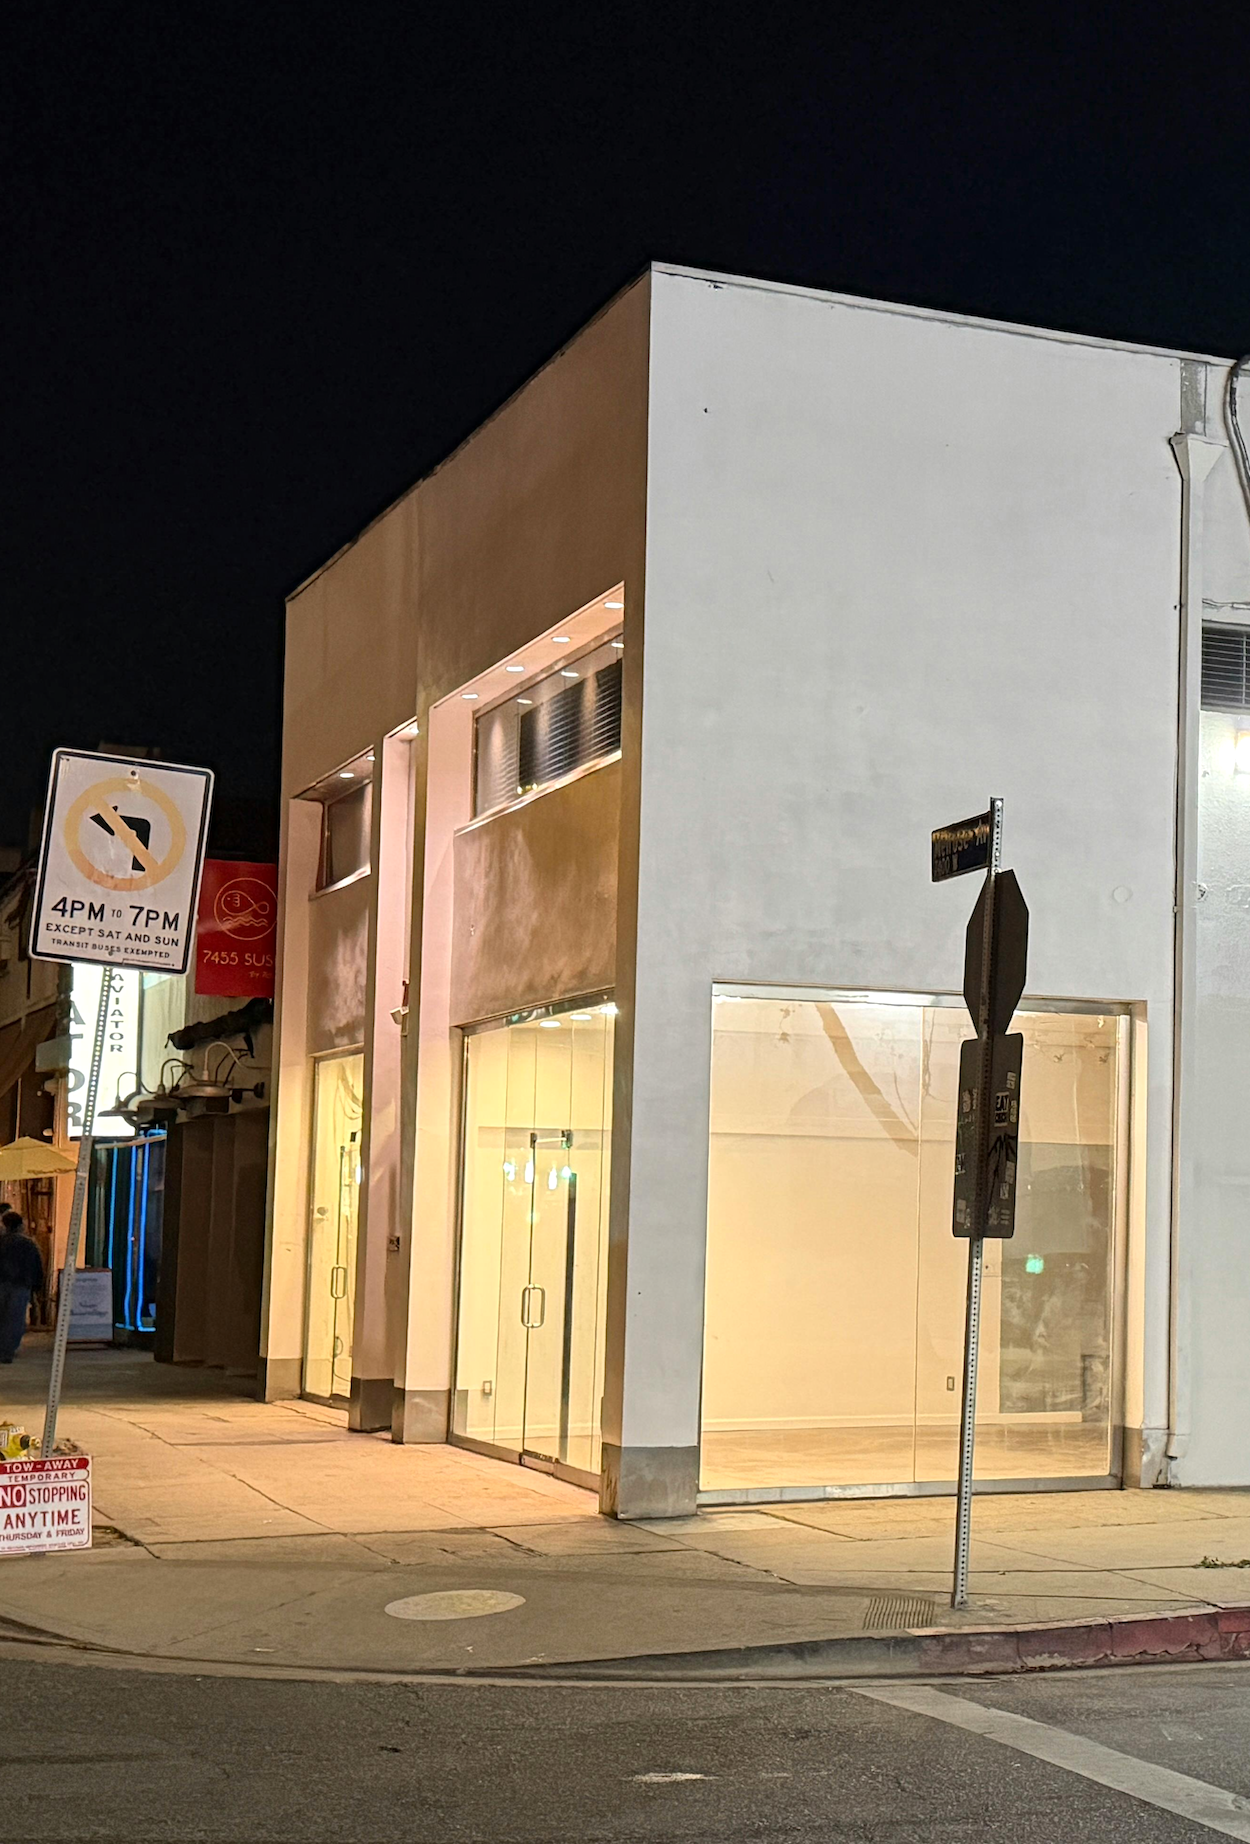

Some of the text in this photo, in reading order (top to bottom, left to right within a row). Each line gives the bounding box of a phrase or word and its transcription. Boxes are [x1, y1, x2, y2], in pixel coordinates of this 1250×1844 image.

[51, 896, 180, 931] 4PM TO 7PM
[45, 922, 180, 947] EXCEPT SAT AND SUN
[51, 938, 170, 959] TRANSIT BUSES EXEMPTED
[203, 951, 241, 965] 7455
[109, 974, 124, 1053] AVIATOR
[9, 1472, 76, 1483] TEMPORARY
[0, 1485, 86, 1506] NO STOPPING
[4, 1509, 81, 1530] ANYTIME
[56, 1528, 85, 1537] FRIDAY
